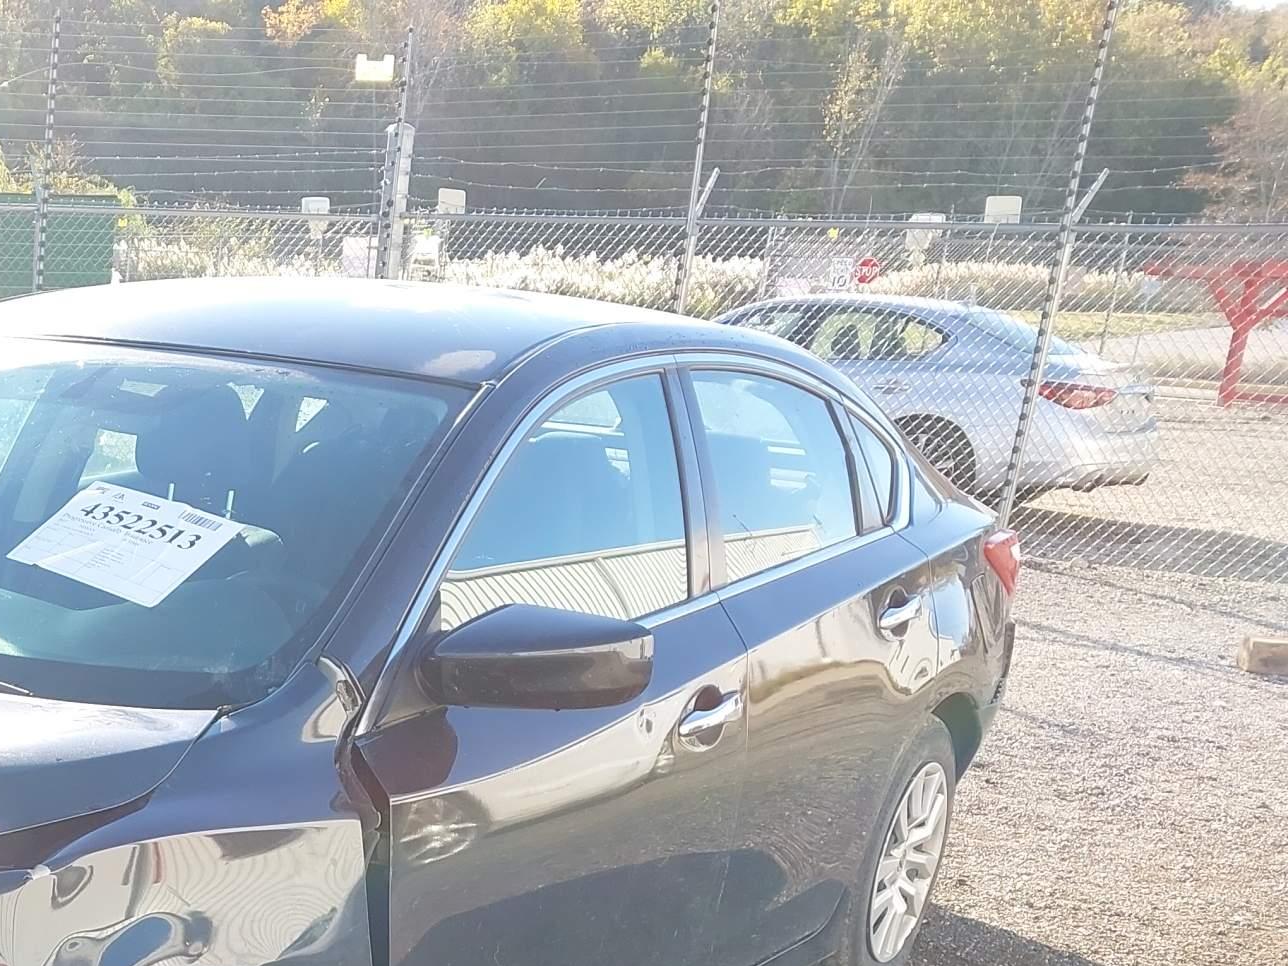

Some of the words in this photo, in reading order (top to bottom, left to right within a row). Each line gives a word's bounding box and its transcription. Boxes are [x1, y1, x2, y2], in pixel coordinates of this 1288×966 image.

[855, 265, 878, 277] STOP
[832, 275, 847, 288] 10
[80, 502, 202, 550] 43522513
